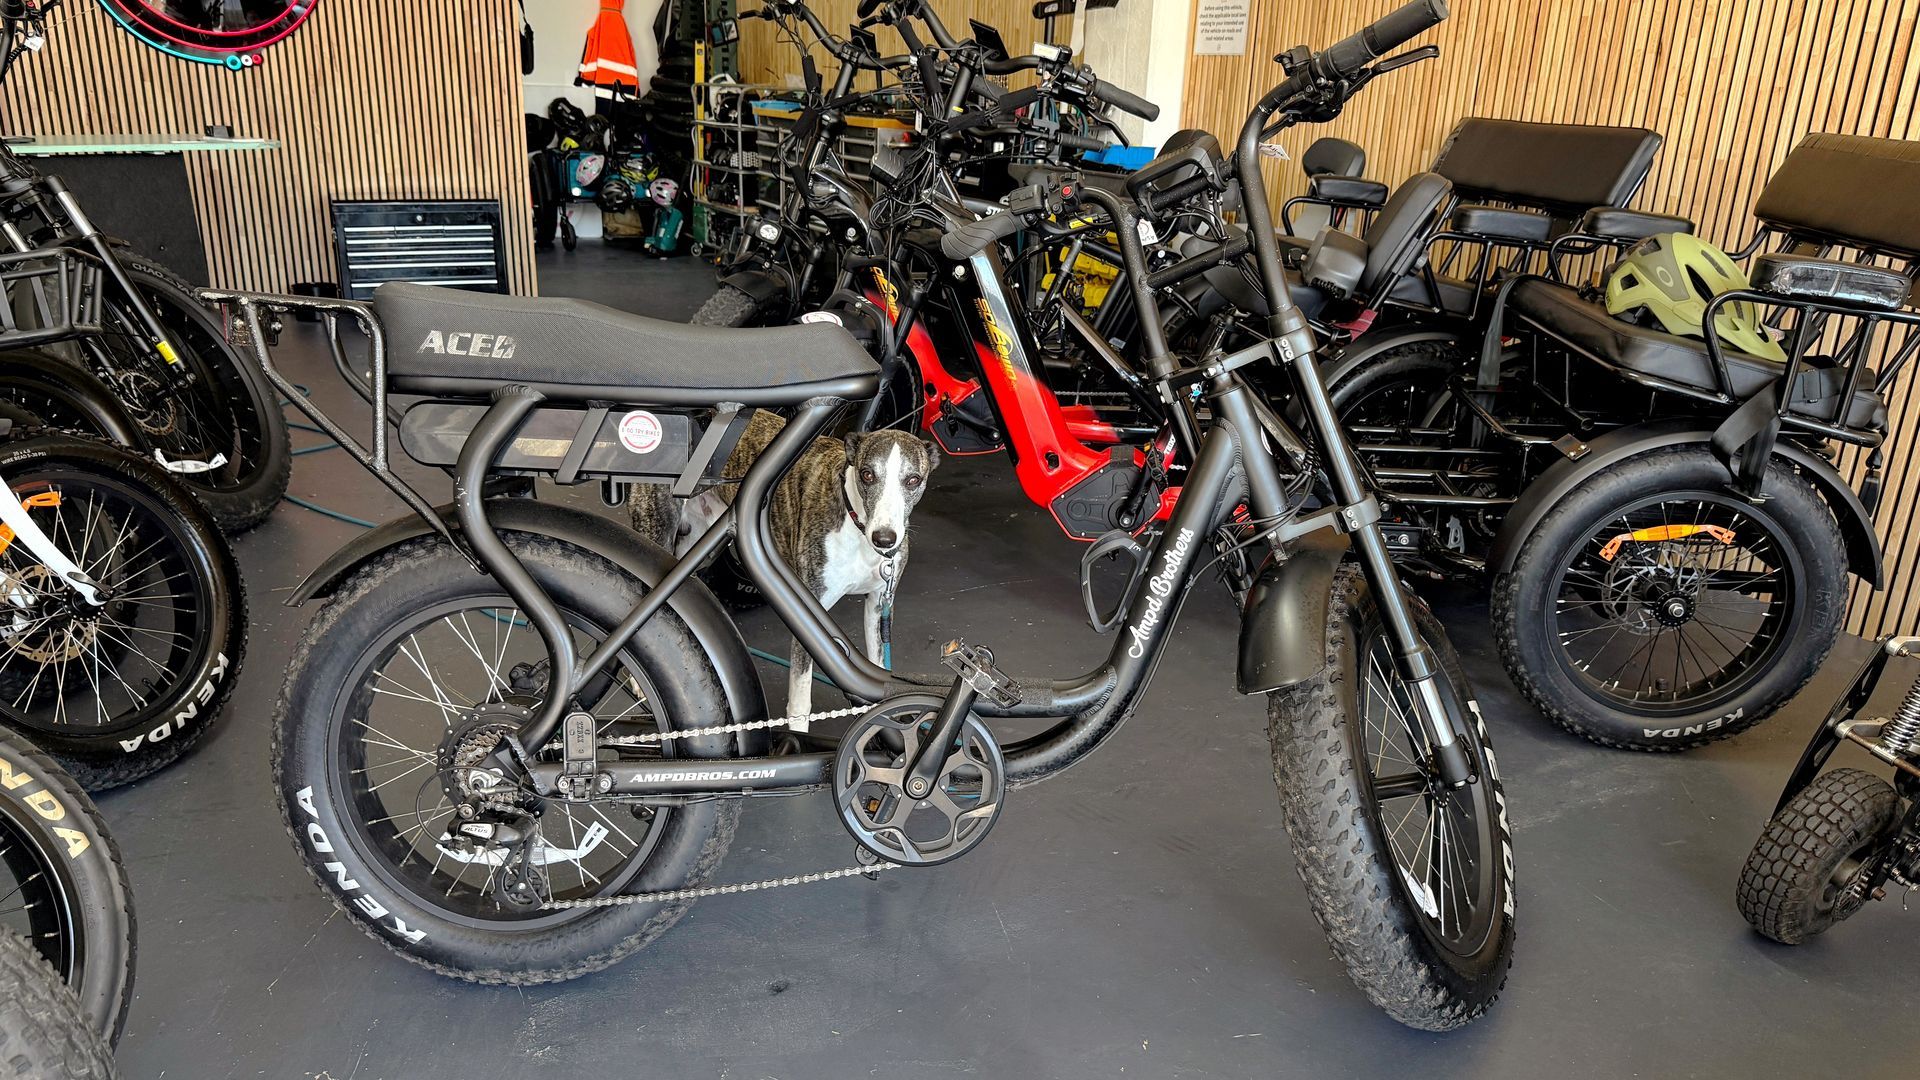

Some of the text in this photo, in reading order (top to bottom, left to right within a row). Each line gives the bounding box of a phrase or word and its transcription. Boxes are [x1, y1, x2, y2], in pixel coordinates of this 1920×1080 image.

[1128, 527, 1195, 658] Ampd Brothers
[118, 652, 230, 753] KENDA
[1643, 707, 1745, 738] KENDA
[629, 769, 777, 783] AMPDBROS.COM
[1467, 700, 1515, 920] KENDA
[295, 785, 428, 945] KENDA
